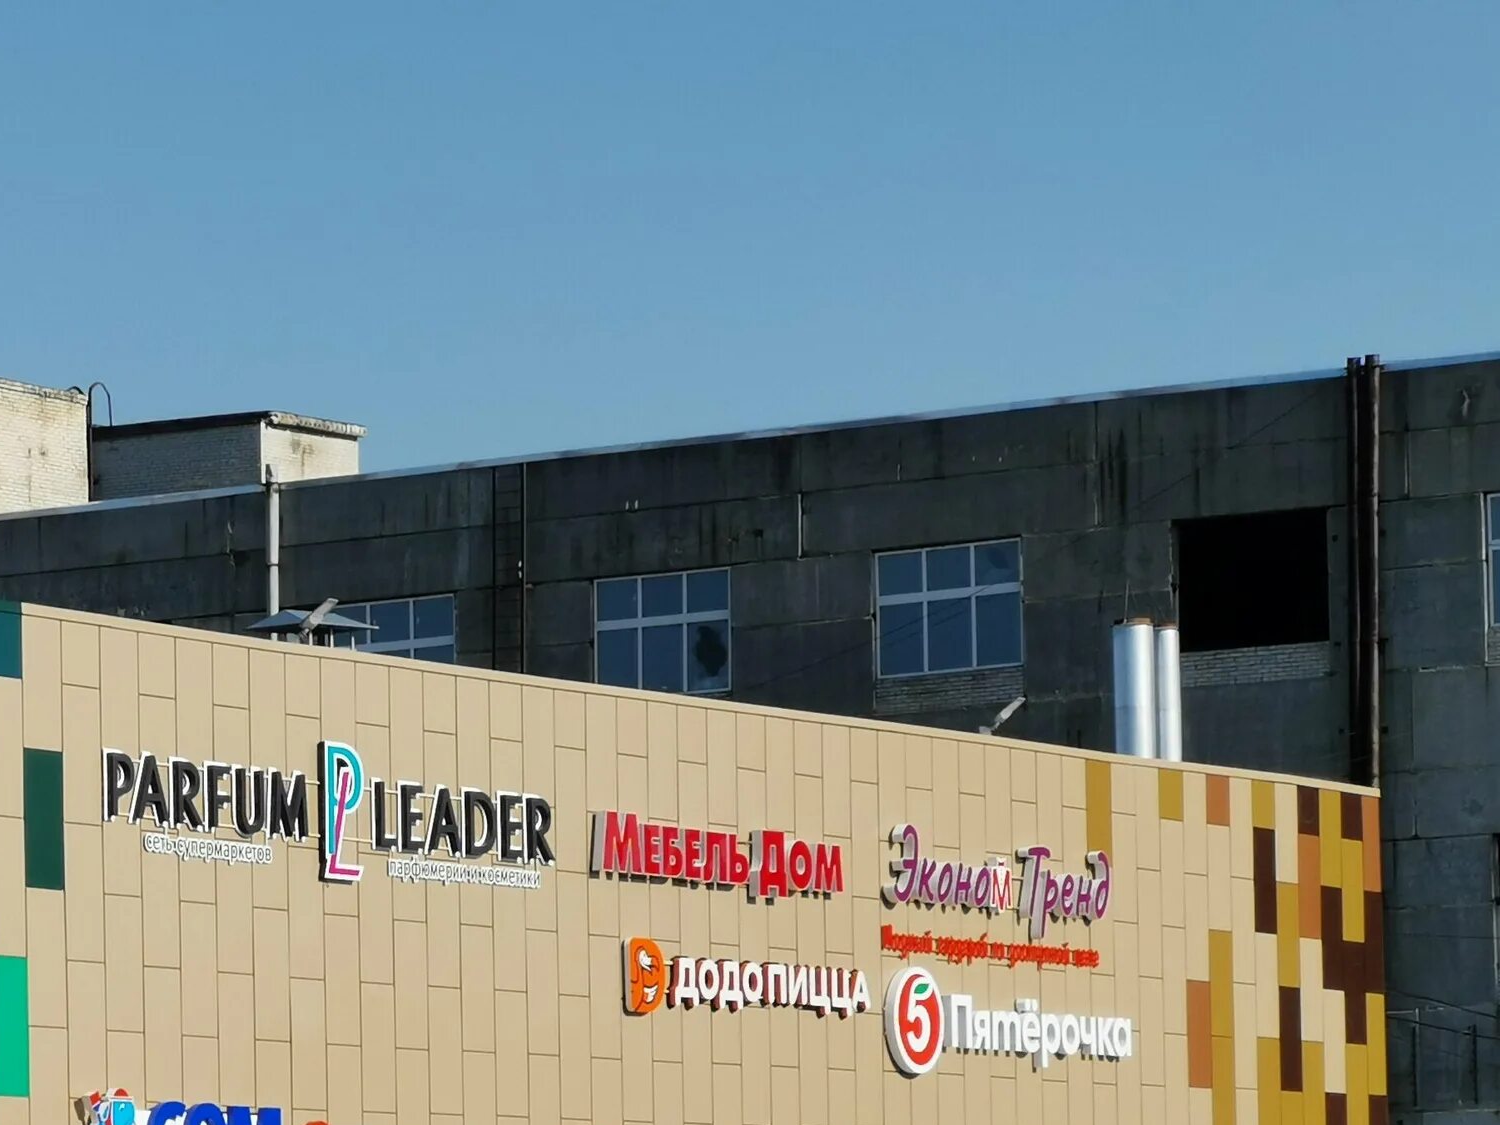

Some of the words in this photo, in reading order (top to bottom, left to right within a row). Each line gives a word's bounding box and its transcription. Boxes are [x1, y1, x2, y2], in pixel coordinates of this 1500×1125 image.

[102, 746, 308, 843] PARFUM
[371, 777, 556, 866] LEADER
[145, 832, 174, 853] сеть
[177, 837, 273, 865] супермаркетов
[388, 856, 468, 885] парфюмерии
[481, 866, 541, 889] косметики
[1022, 844, 1112, 939] Тренд
[906, 977, 935, 1053] 5
[948, 993, 1133, 1068] Пятёрочка
